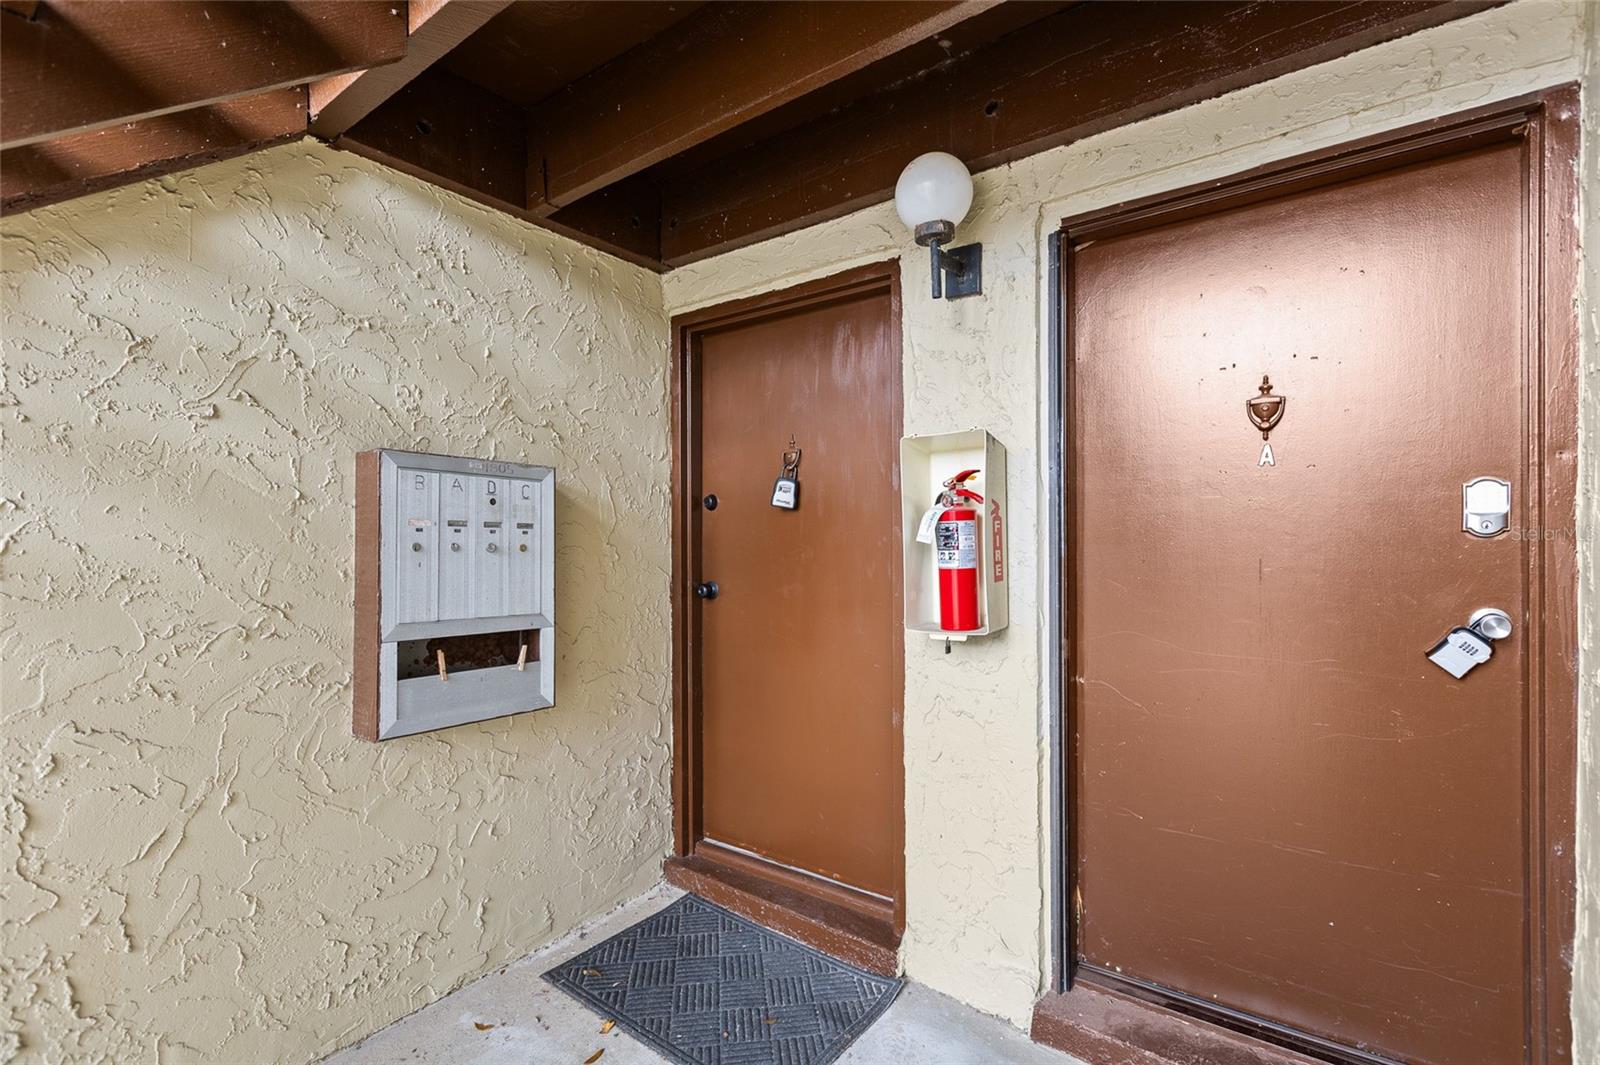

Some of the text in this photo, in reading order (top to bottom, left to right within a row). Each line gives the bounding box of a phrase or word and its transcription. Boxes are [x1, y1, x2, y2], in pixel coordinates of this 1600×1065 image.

[1258, 443, 1276, 466] A
[416, 475, 530, 499] B A D C
